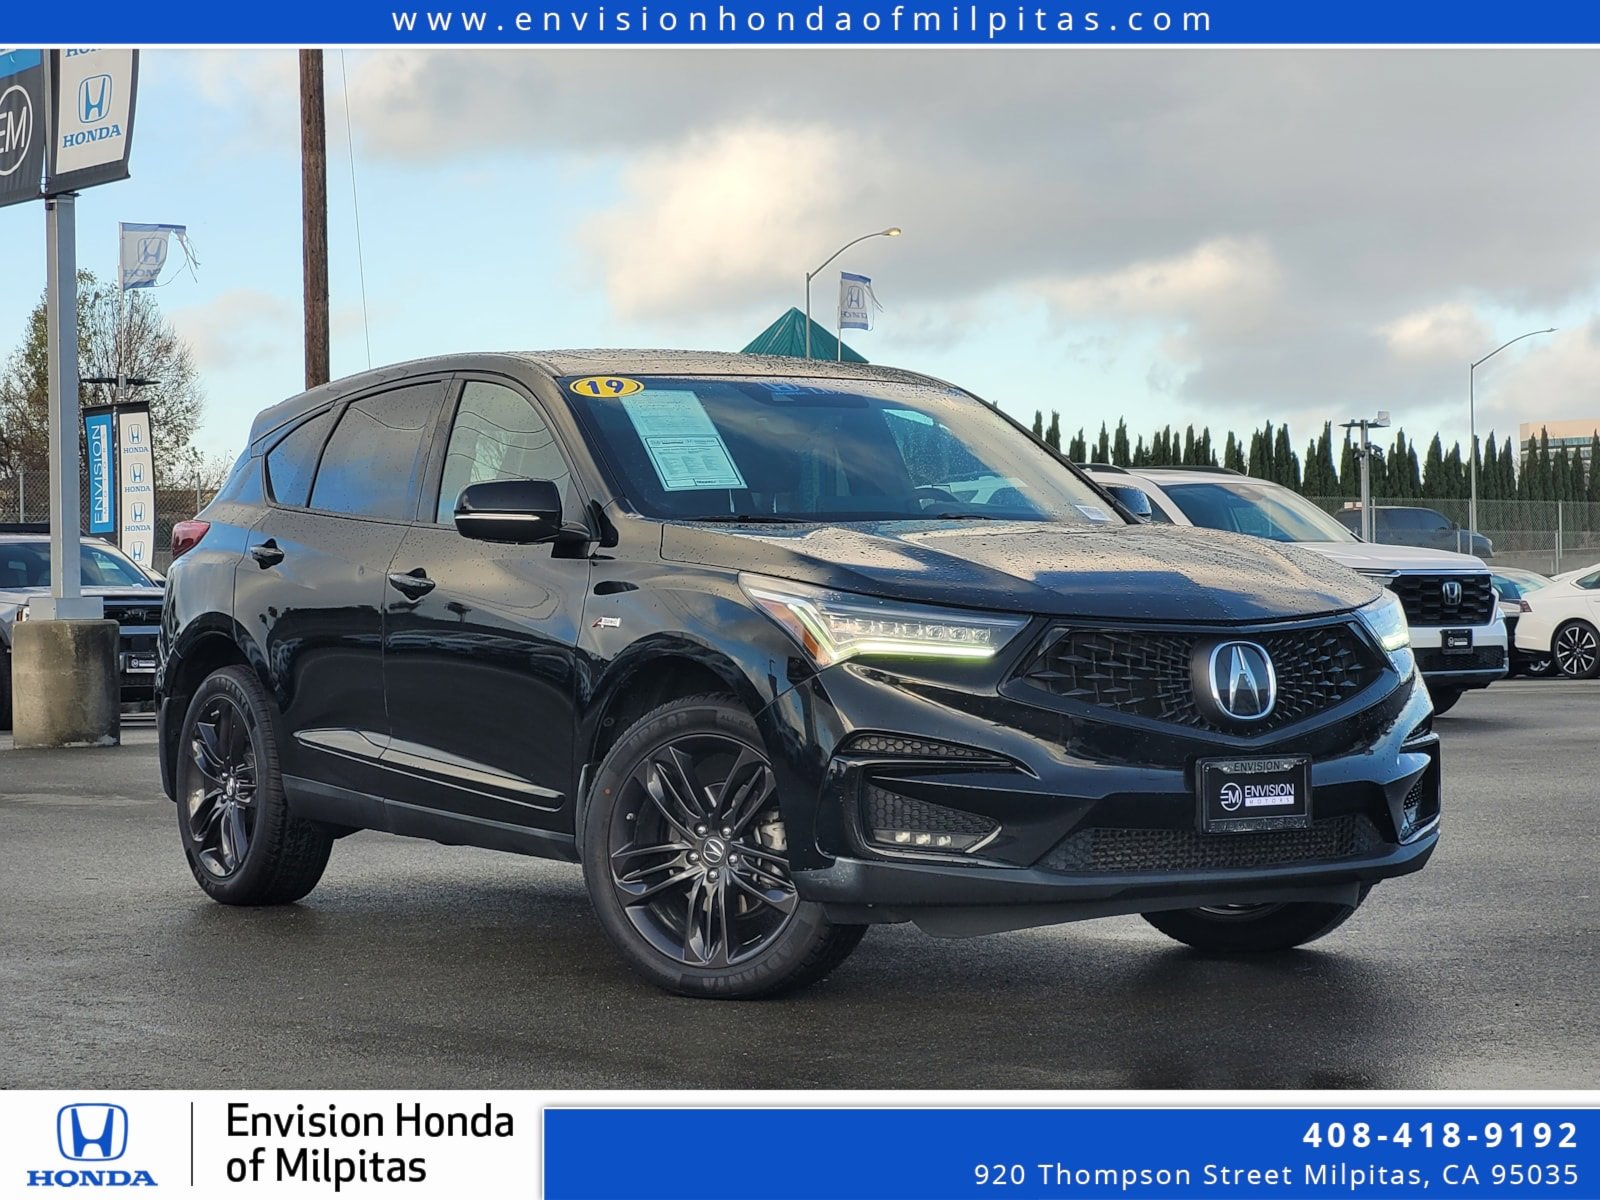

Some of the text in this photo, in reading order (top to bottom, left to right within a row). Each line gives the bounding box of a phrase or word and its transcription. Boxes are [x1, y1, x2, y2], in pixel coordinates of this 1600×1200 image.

[62, 124, 122, 148] HONDA
[586, 379, 624, 395] 19
[123, 446, 149, 454] HONDA
[91, 425, 103, 524] ENVISION
[124, 485, 151, 493] HONDA
[124, 524, 151, 532] HONDA
[1234, 761, 1281, 772] ENVISION
[1245, 784, 1295, 798] ENVISION
